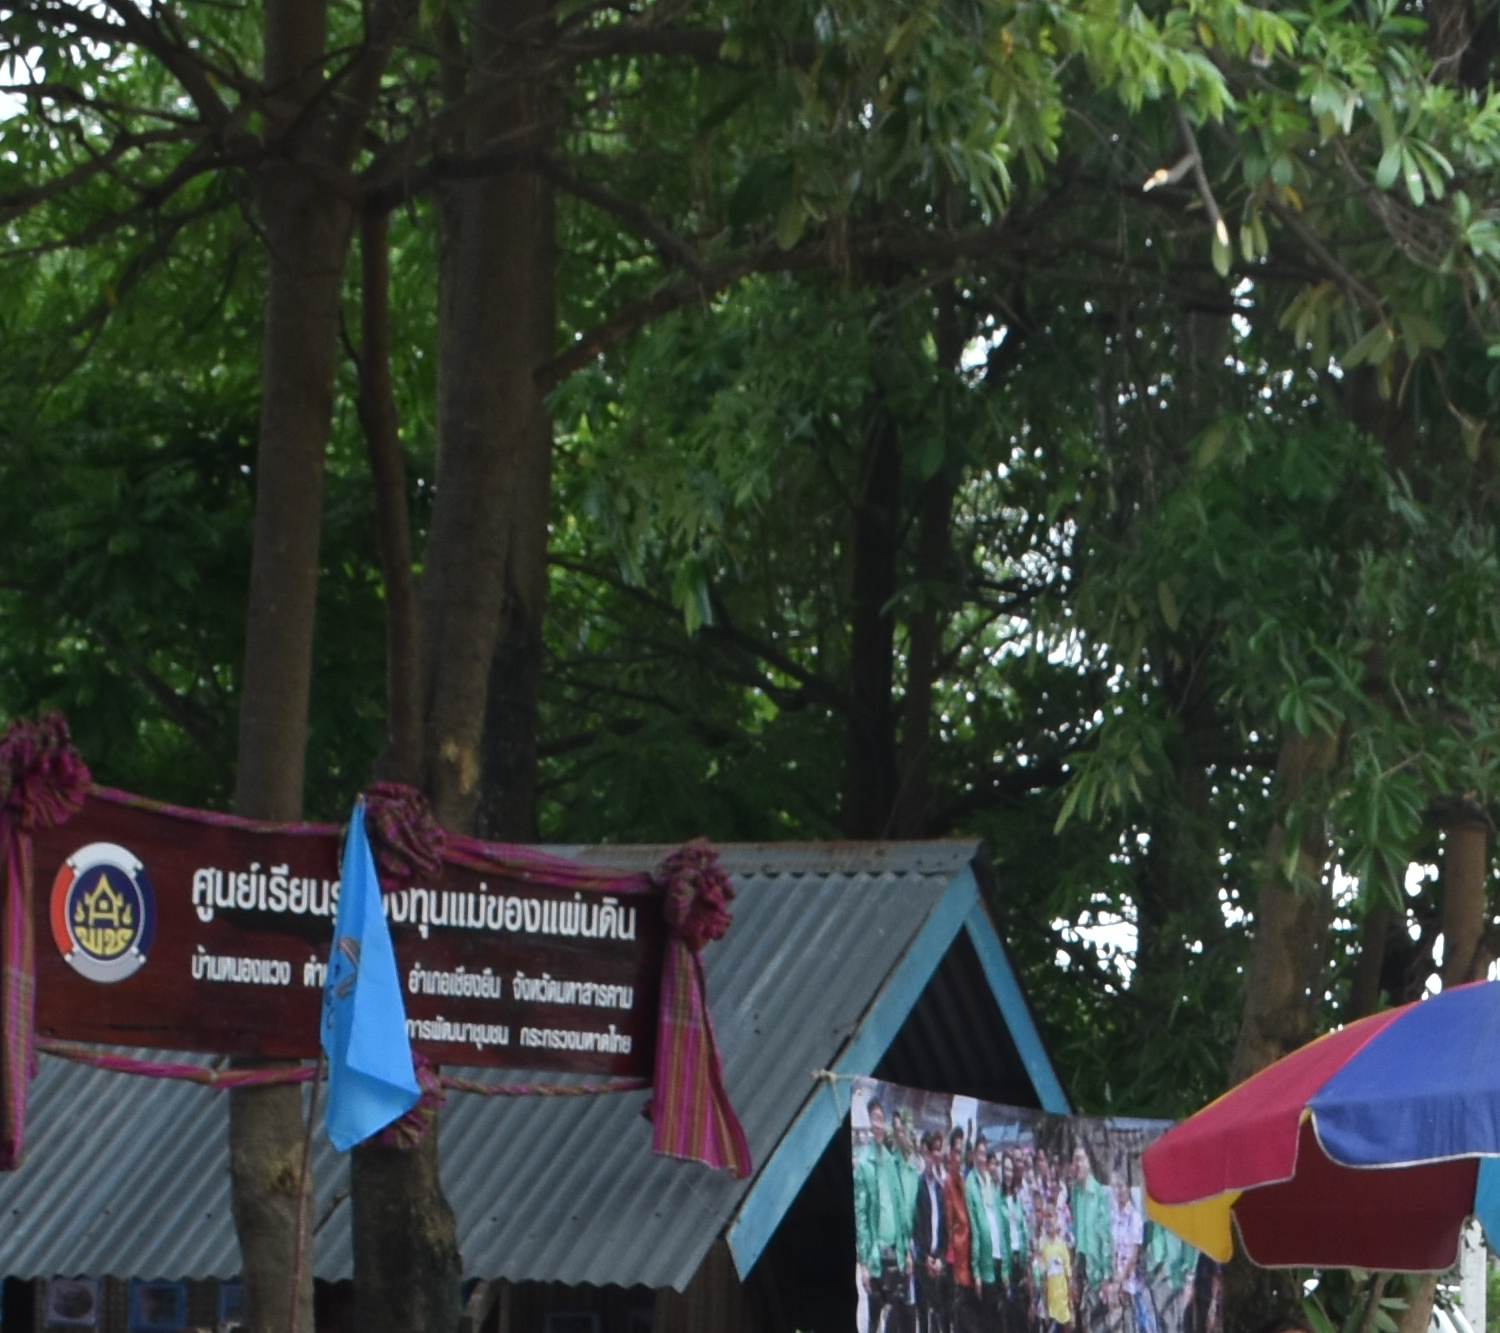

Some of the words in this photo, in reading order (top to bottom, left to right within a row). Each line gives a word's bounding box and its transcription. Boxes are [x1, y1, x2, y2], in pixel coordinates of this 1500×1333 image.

[191, 944, 291, 985] บ้านหนองแวง
[512, 969, 634, 1009] จังหวัดมหาสารคาม
[406, 1014, 509, 1051] การพัฒนาชุมชน
